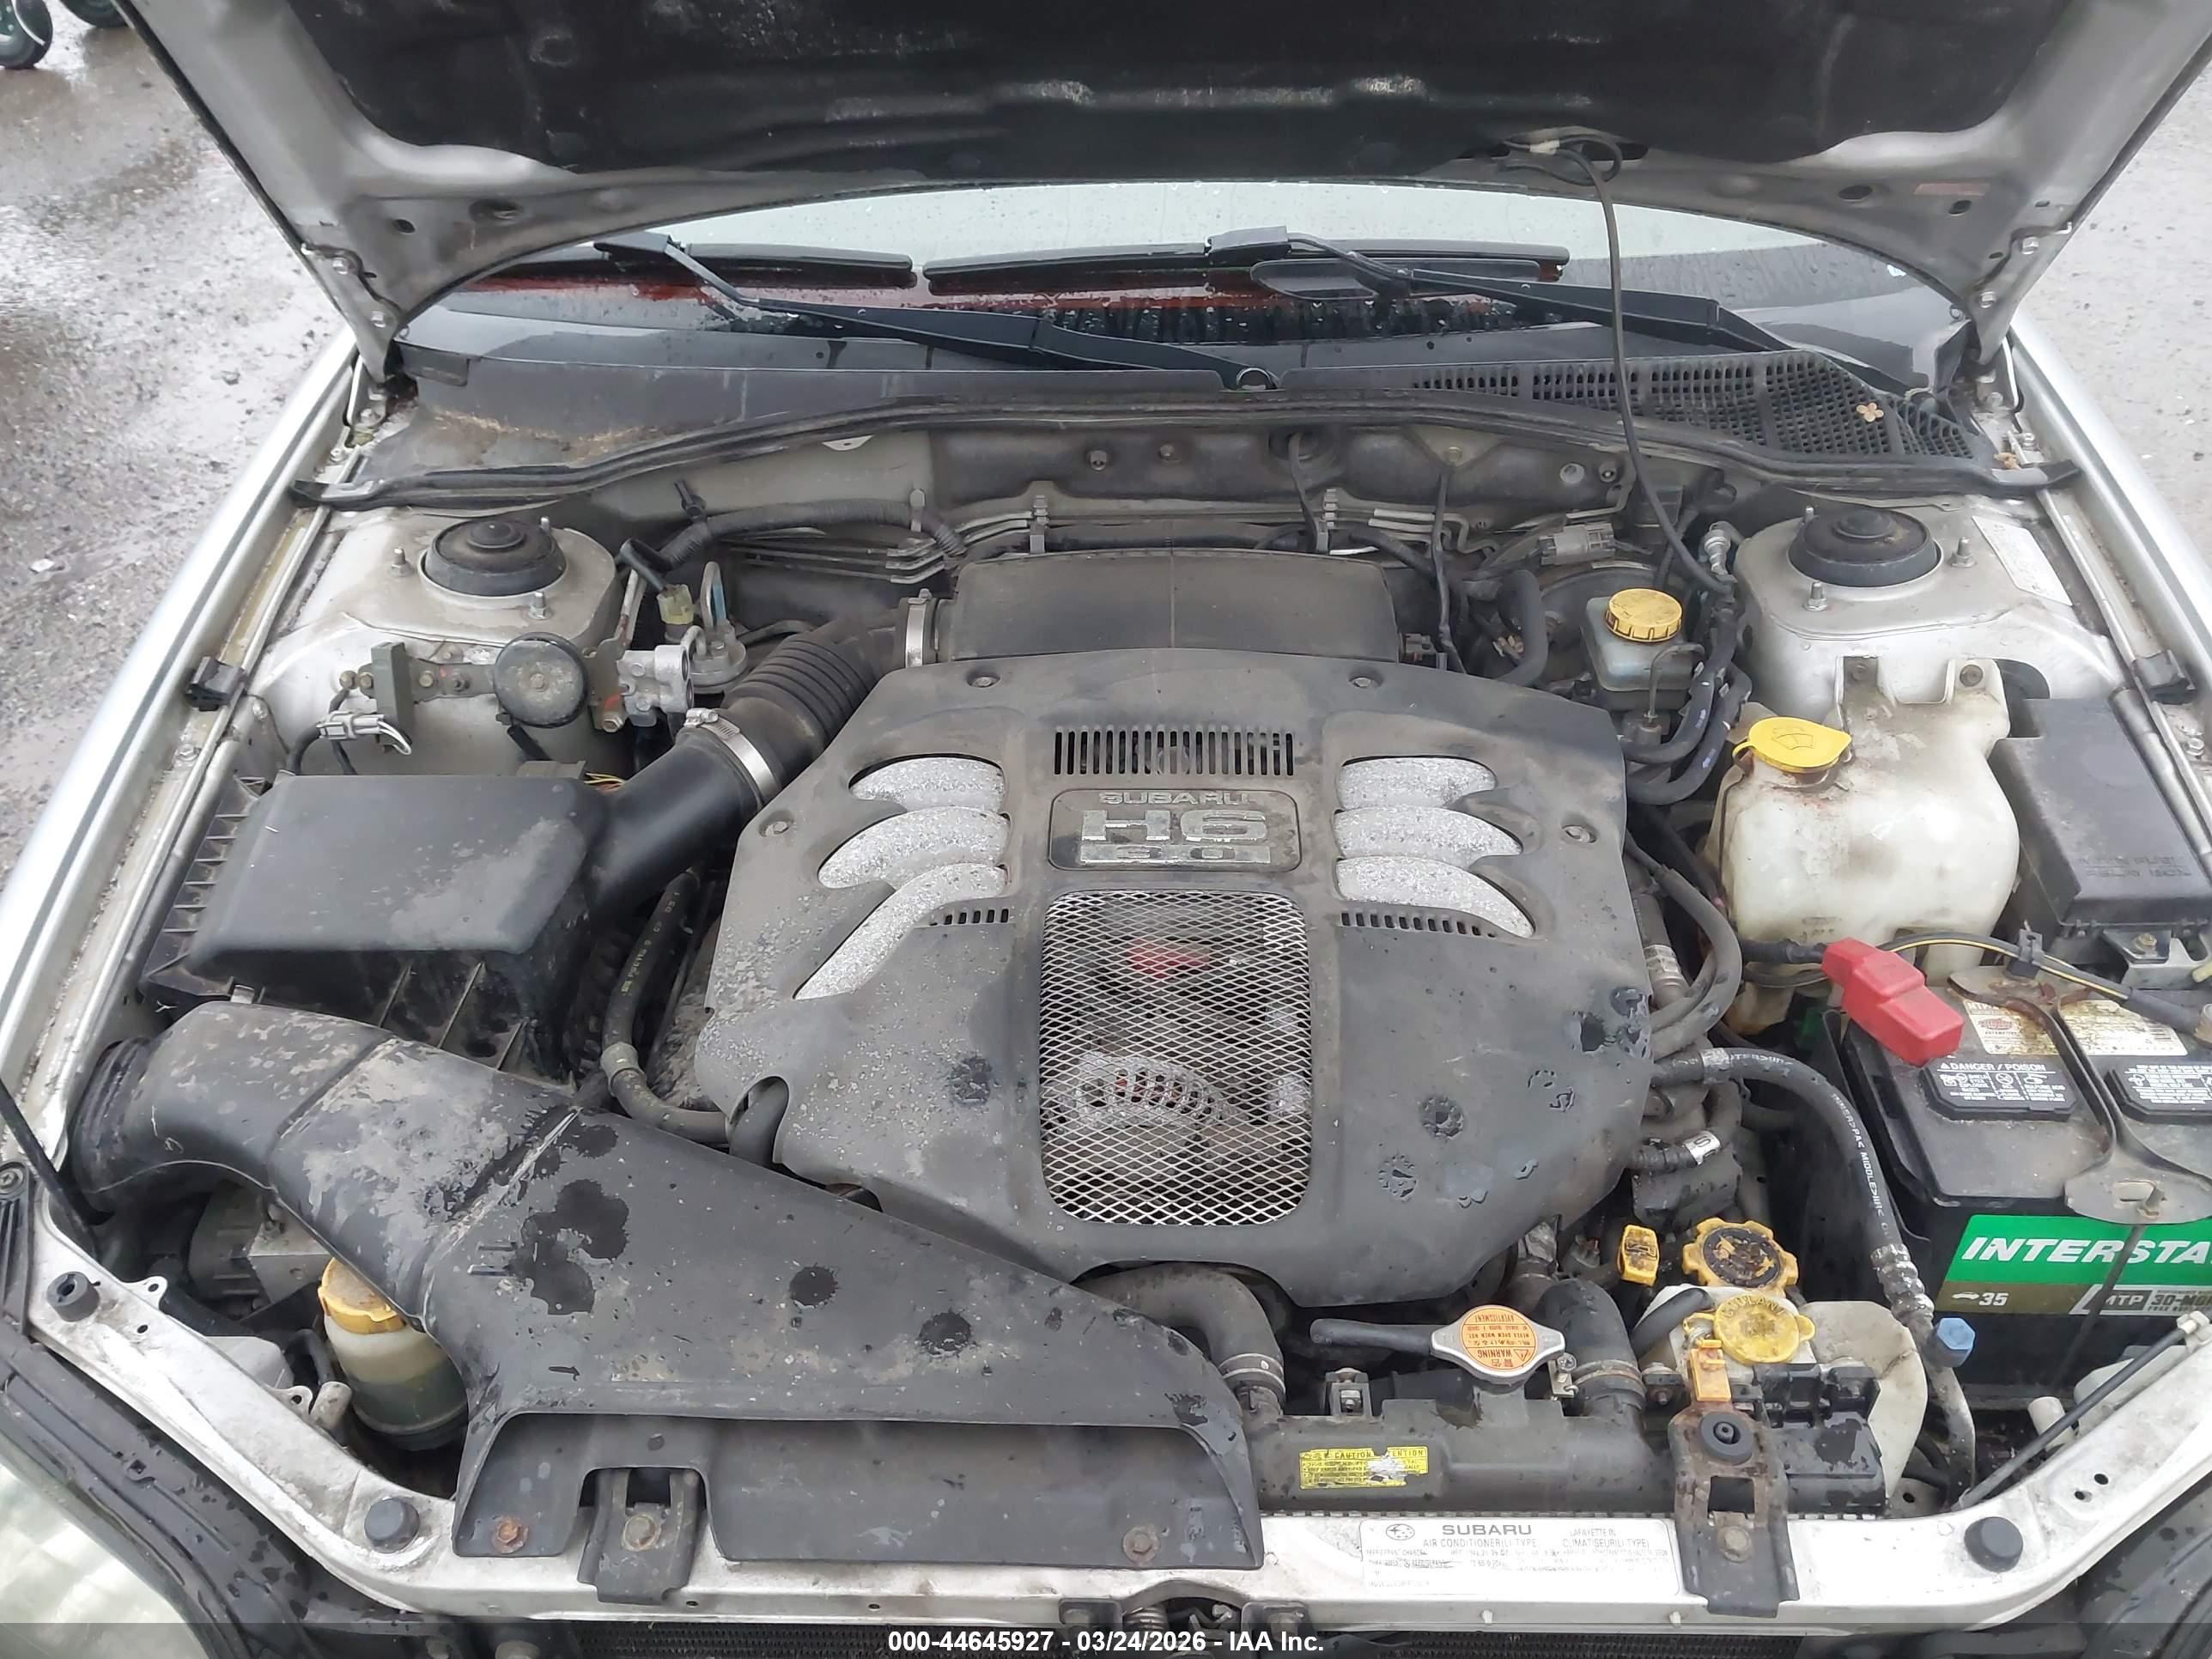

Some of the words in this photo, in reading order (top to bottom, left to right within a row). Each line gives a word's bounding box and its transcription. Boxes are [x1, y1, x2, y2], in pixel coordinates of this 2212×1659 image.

[1098, 791, 1251, 805] SUBARU
[1961, 1237, 2212, 1264] INTERSTA
[1978, 1292, 2009, 1306] 35
[1477, 1348, 1513, 1358] WARNING
[1442, 1524, 1533, 1535] SUBARU
[1423, 1538, 1437, 1547] AIR
